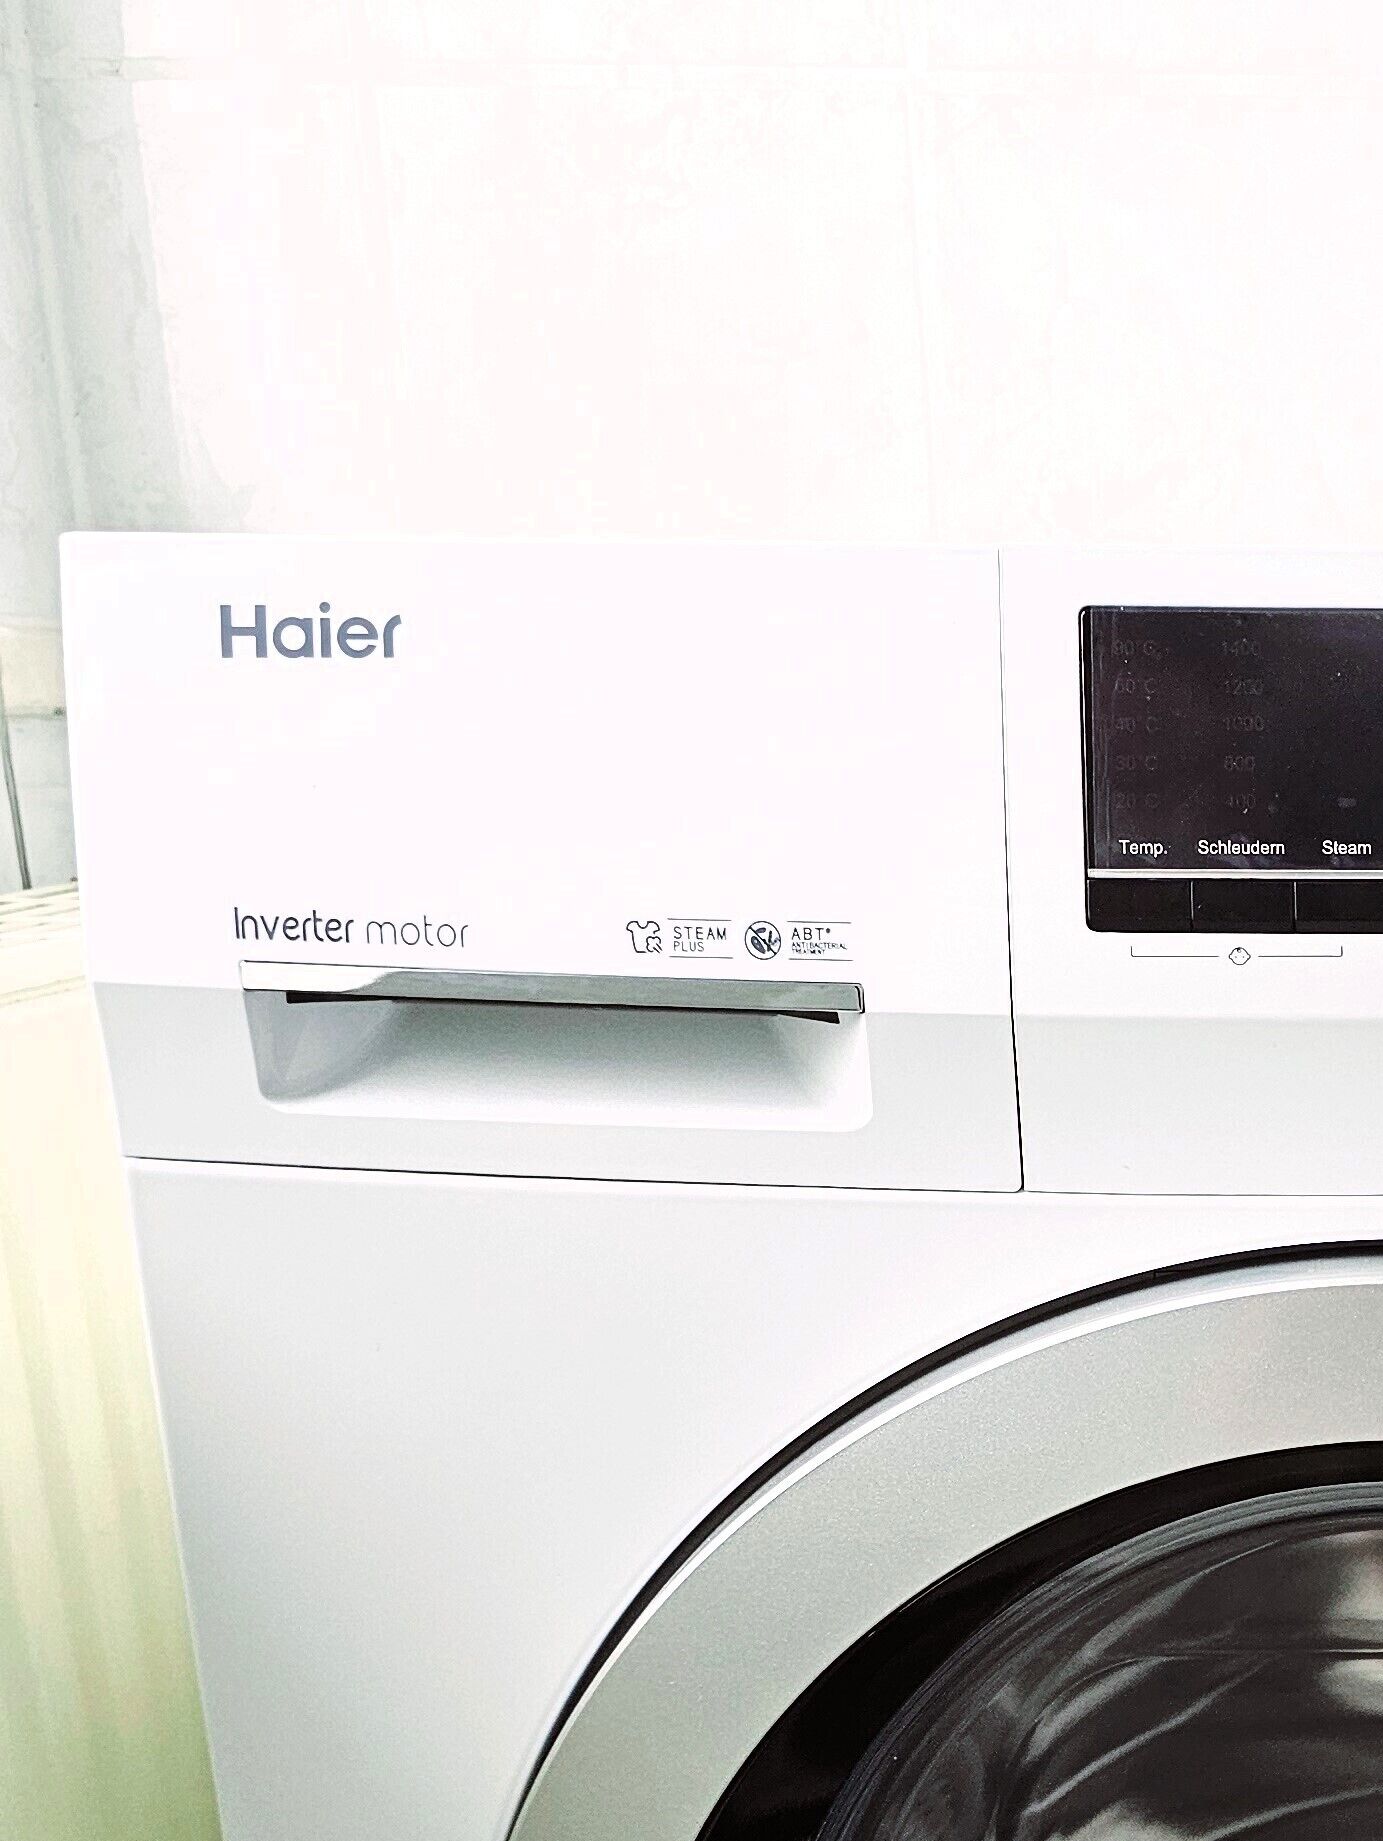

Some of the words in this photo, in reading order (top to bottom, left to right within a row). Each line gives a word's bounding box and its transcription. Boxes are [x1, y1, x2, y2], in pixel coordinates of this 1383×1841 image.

[219, 601, 402, 659] Haier
[1118, 839, 1168, 859] Temp.
[1197, 839, 1286, 855] Schleudern
[1321, 839, 1372, 855] Steam
[233, 906, 355, 944] Inverter
[366, 914, 469, 948] motor
[673, 925, 728, 940] STEAM
[673, 940, 705, 953] PLUS
